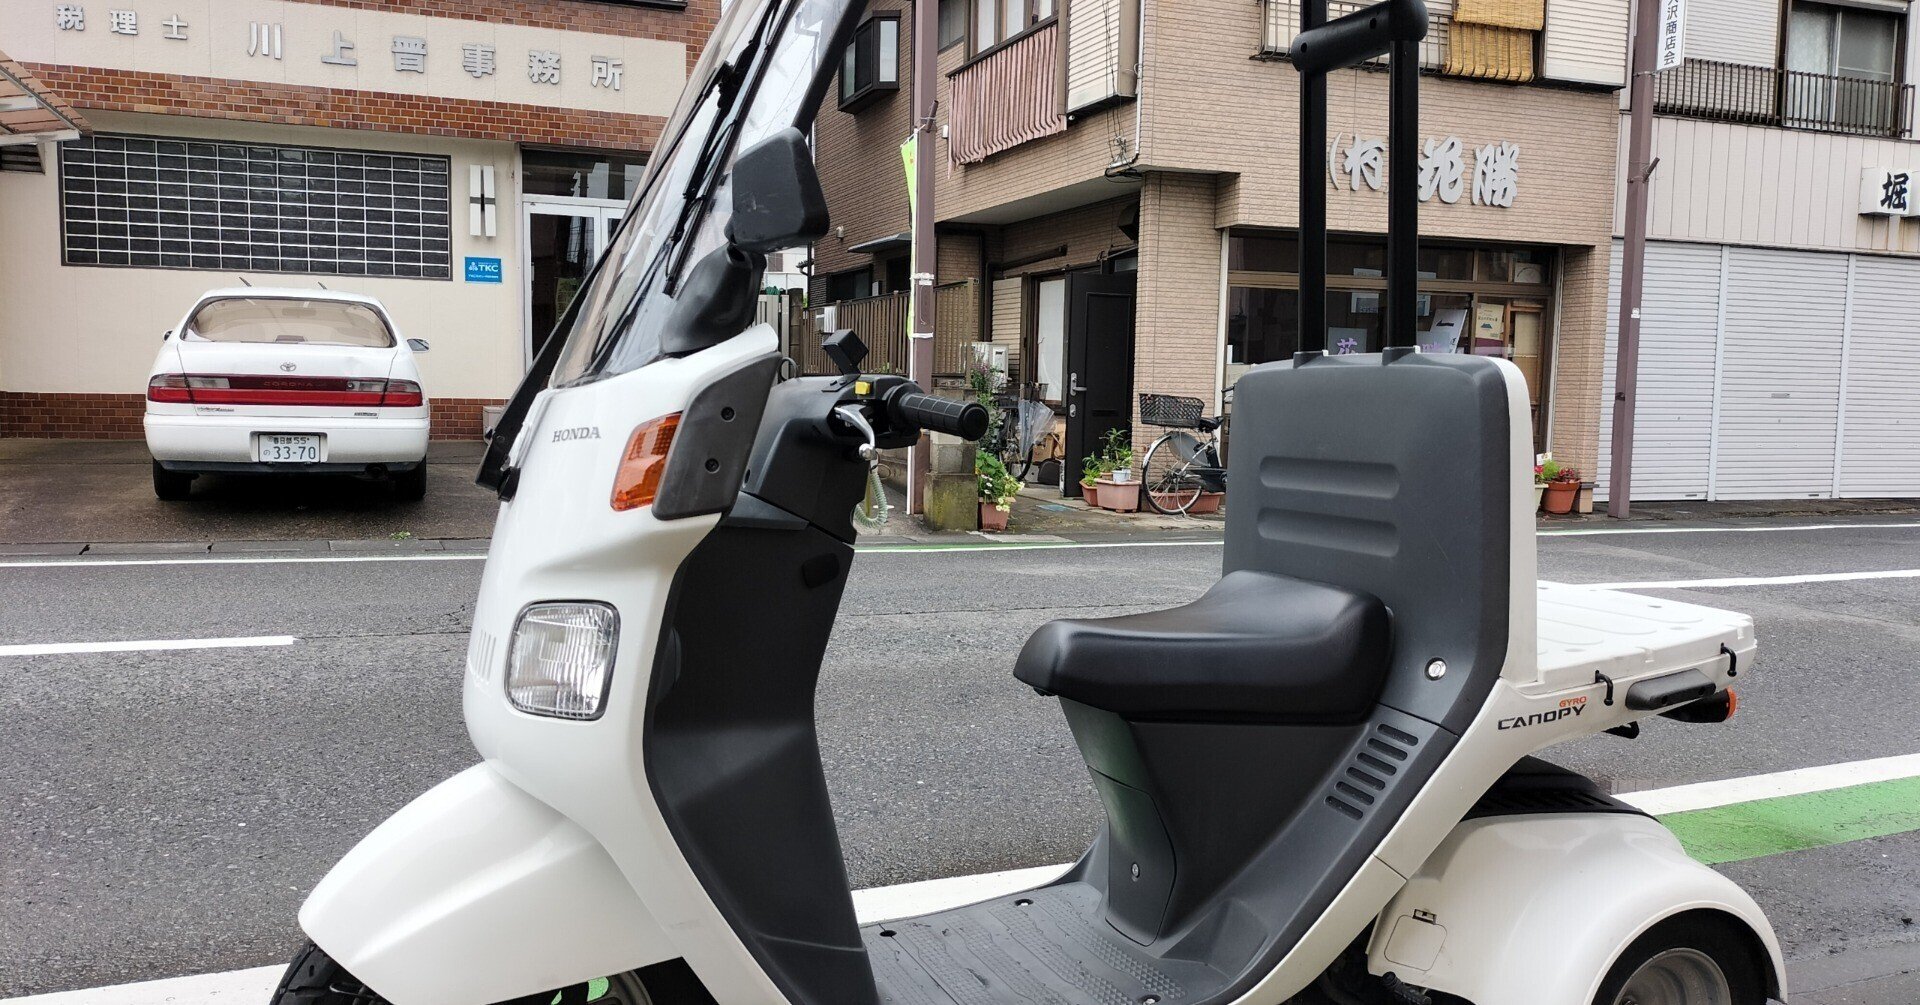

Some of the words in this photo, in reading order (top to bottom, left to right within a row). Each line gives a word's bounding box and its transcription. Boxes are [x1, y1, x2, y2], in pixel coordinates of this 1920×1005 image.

[56, 4, 189, 40] 税理士
[1663, 0, 1679, 66] 沢商店会
[1880, 172, 1909, 211] 堀
[478, 264, 499, 272] TKC
[552, 426, 601, 443] HONDA
[273, 446, 316, 460] 33-70
[1559, 696, 1587, 708] GYRO
[1497, 704, 1587, 731] CANOPY
